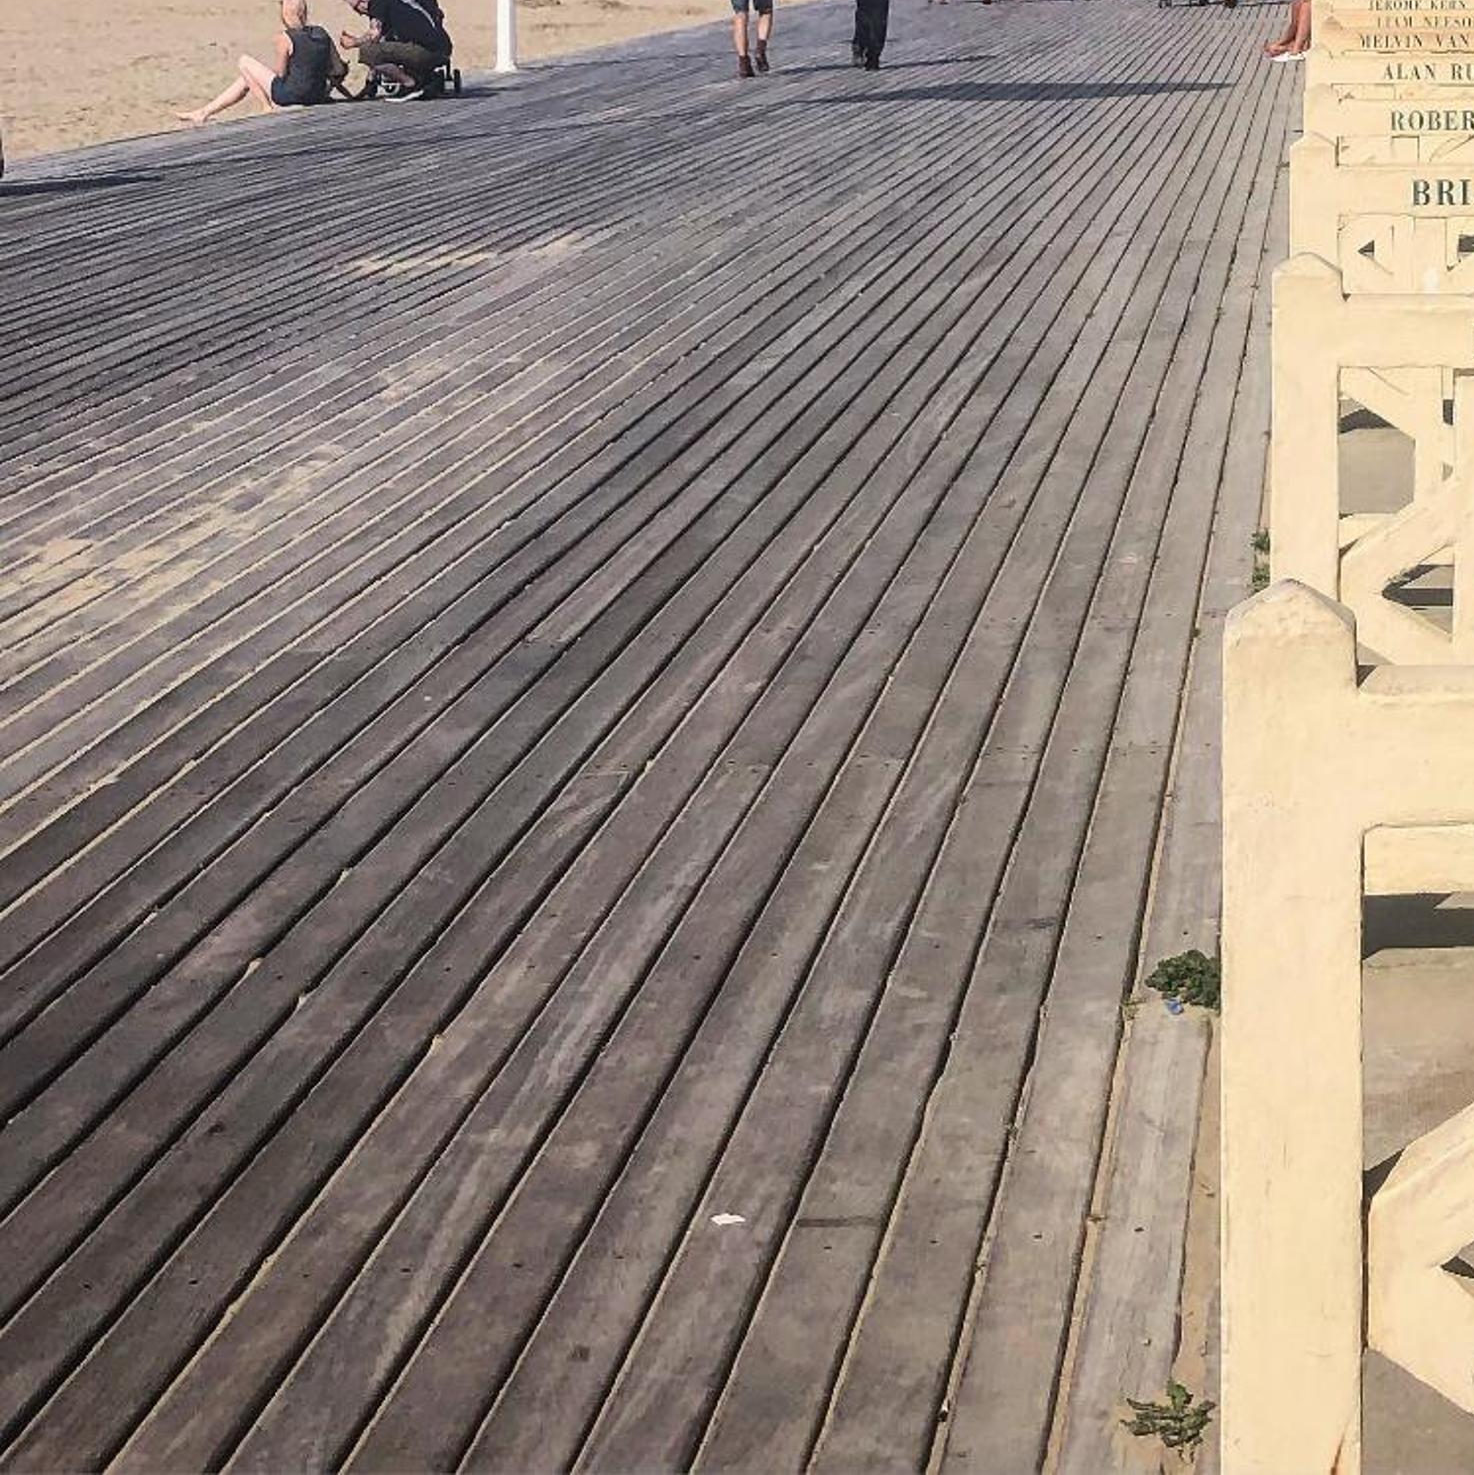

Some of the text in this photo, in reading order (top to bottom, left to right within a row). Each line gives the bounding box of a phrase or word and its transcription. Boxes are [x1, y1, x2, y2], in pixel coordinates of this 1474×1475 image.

[1359, 33, 1423, 49] MELVIN
[1436, 33, 1470, 49] VAN
[1384, 63, 1435, 81] ALAN
